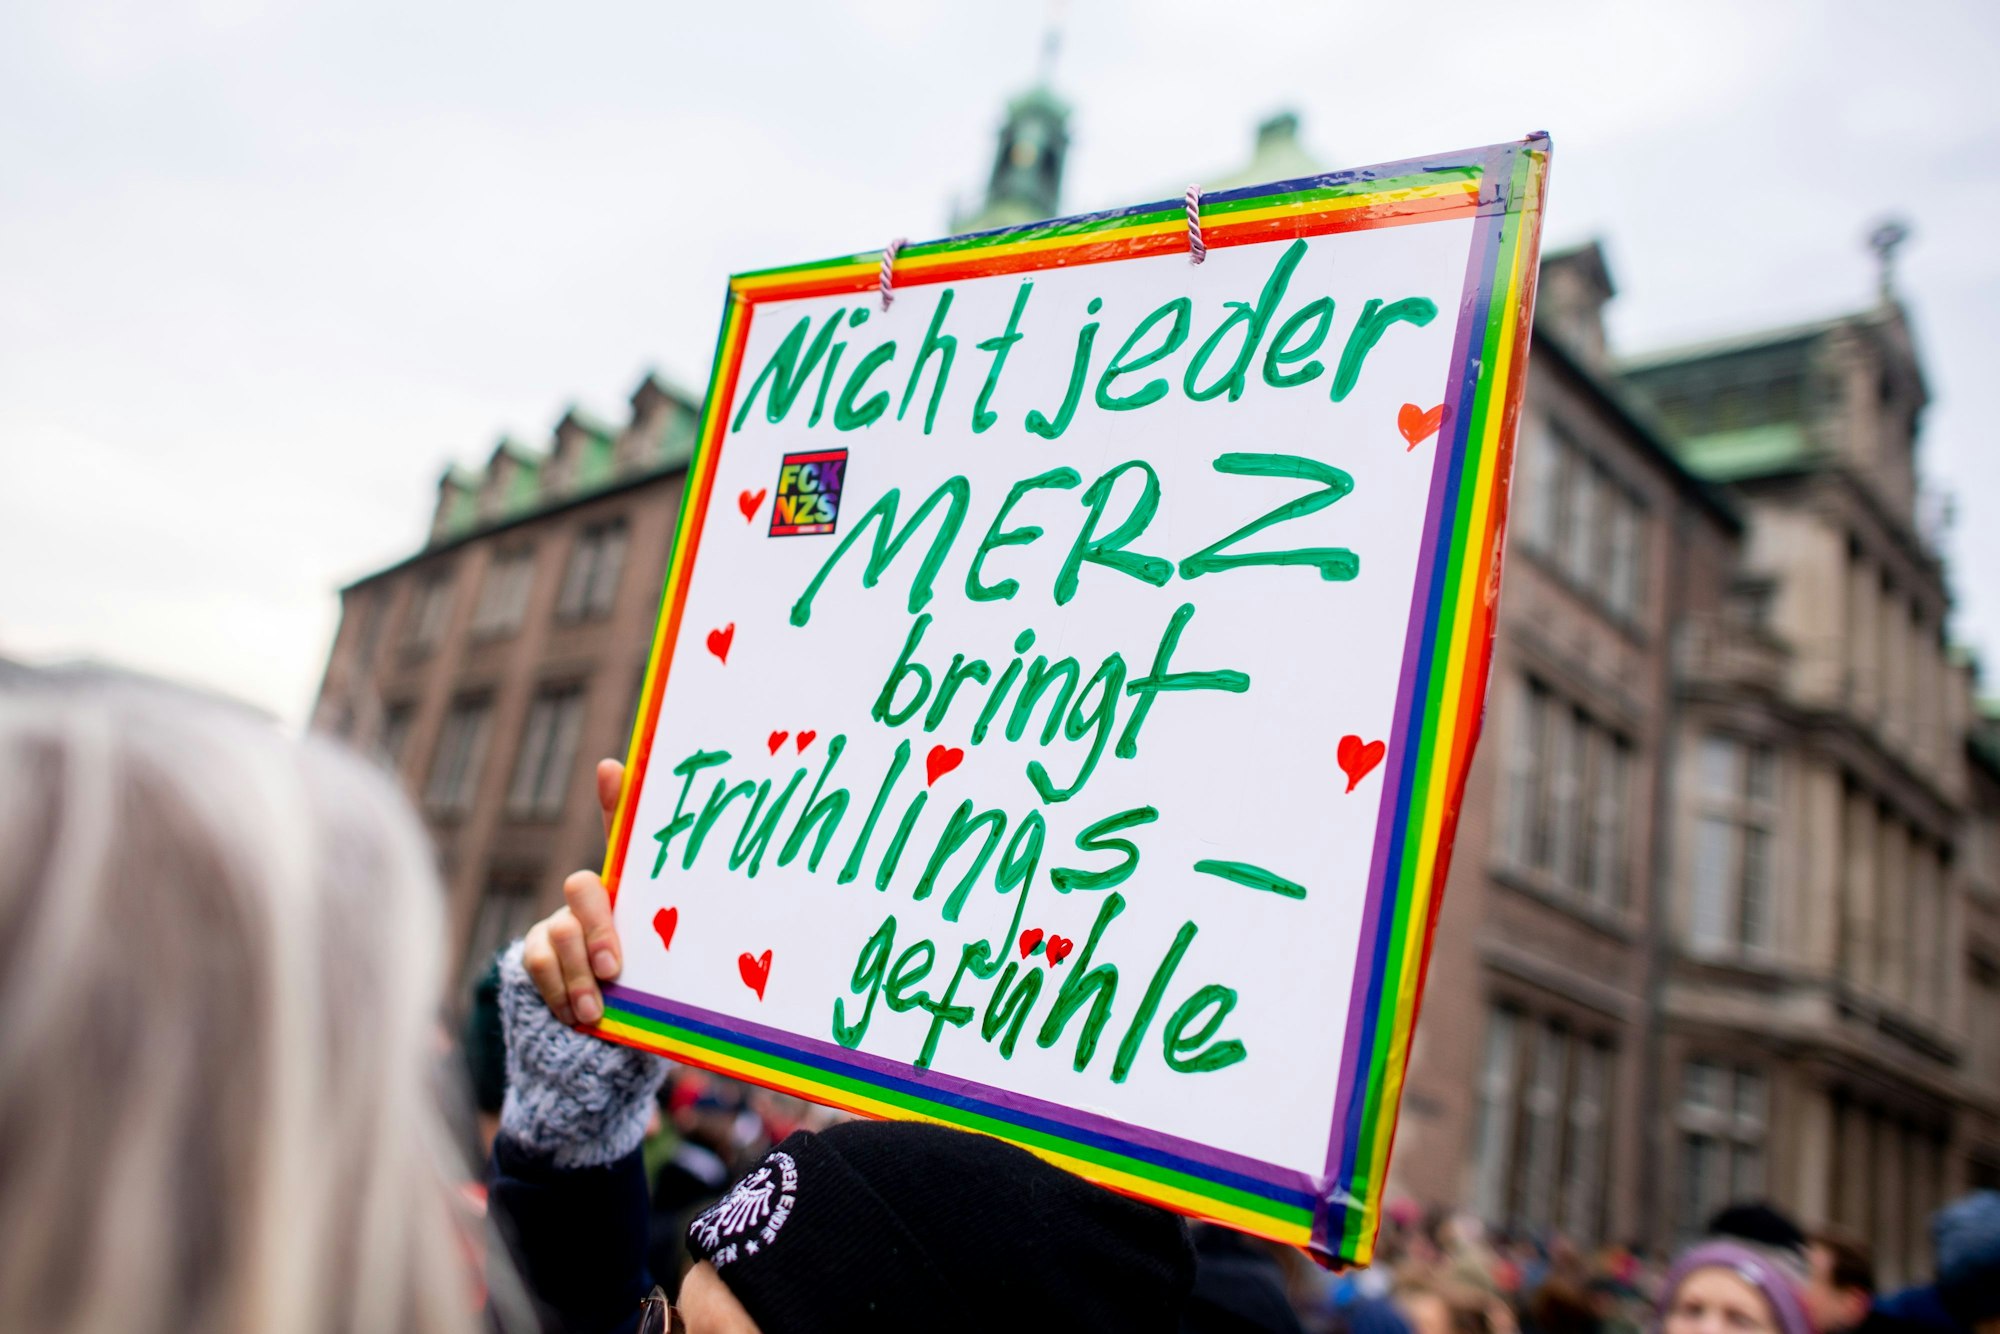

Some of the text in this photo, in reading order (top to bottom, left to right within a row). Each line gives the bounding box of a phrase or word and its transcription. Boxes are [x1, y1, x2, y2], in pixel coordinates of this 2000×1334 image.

[733, 238, 1439, 441] Nicht jeder
[773, 493, 837, 525] NZS
[780, 461, 843, 493] FCK
[789, 452, 1361, 628] MERZ
[871, 602, 1251, 807] bringt
[832, 891, 1249, 1085] gefühle
